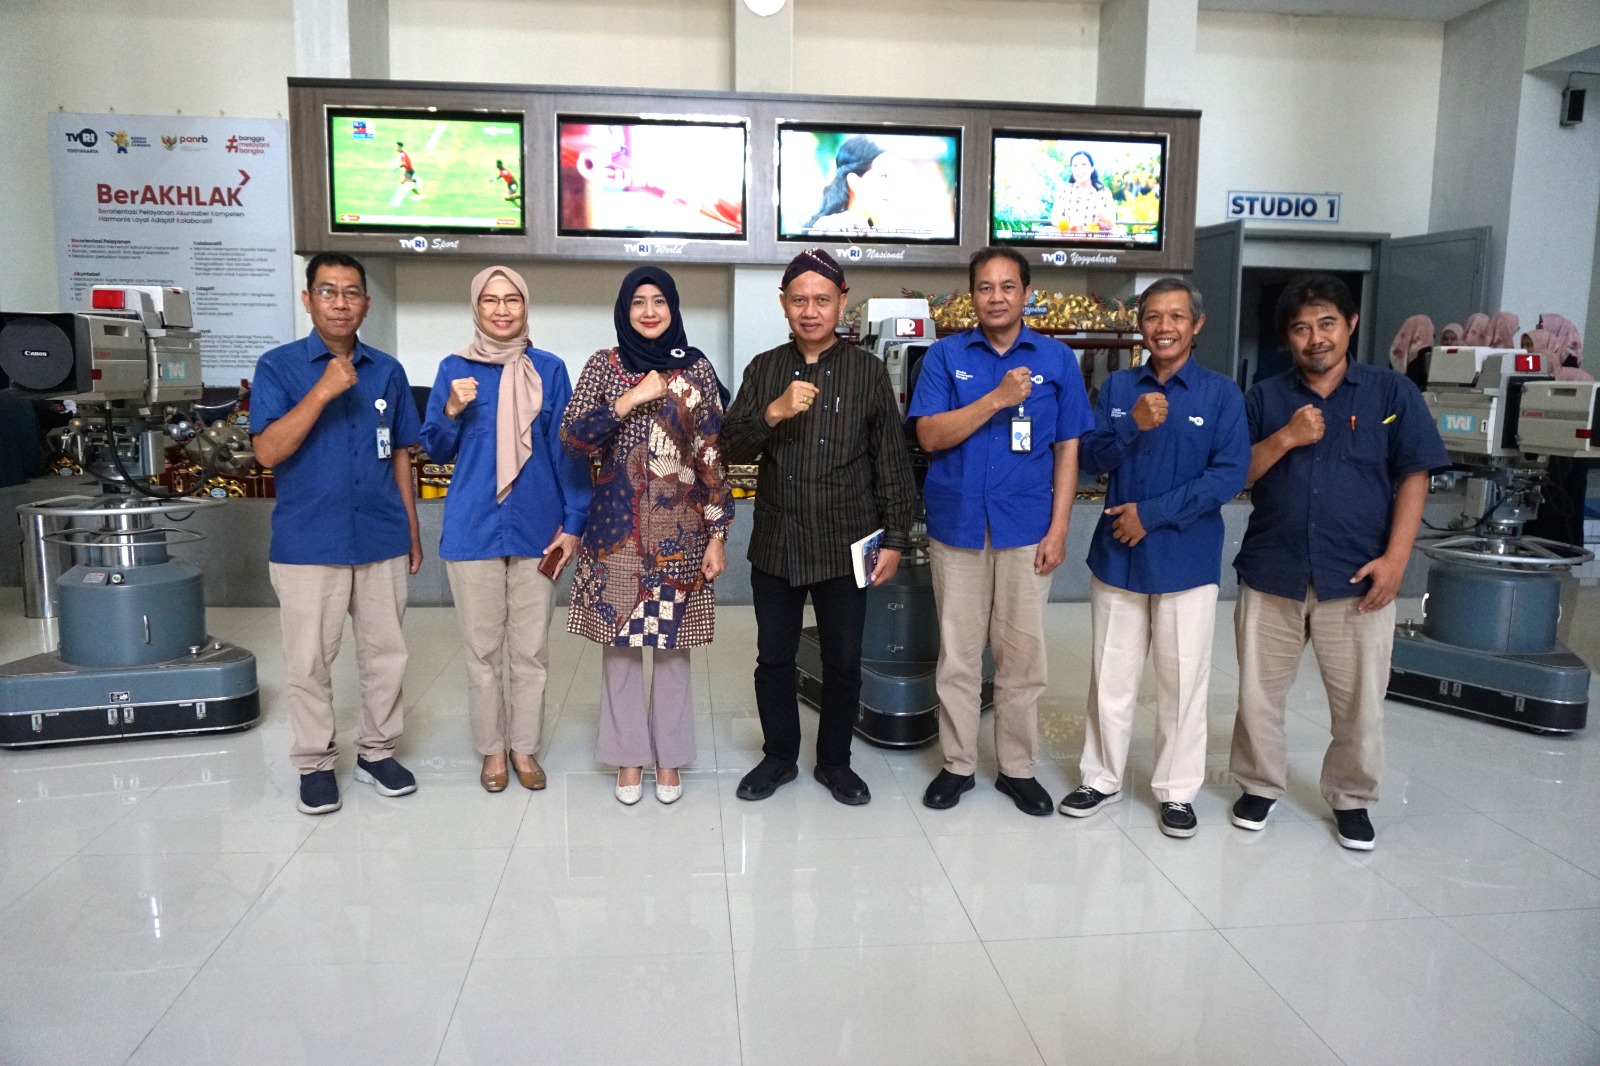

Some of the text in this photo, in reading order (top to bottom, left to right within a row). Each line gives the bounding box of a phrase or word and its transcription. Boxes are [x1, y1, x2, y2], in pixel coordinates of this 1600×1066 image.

[65, 128, 98, 147] TVRI
[180, 135, 208, 144] panrb
[97, 183, 243, 207] BerAKHLAK
[1231, 195, 1336, 218] STUDIO 1
[399, 236, 459, 252] TVRI Sport
[624, 241, 684, 256] TVRI World
[836, 246, 905, 261] TVRI Nasional
[1042, 251, 1117, 266] TVRI Yogyakarta
[1526, 355, 1533, 370] 1
